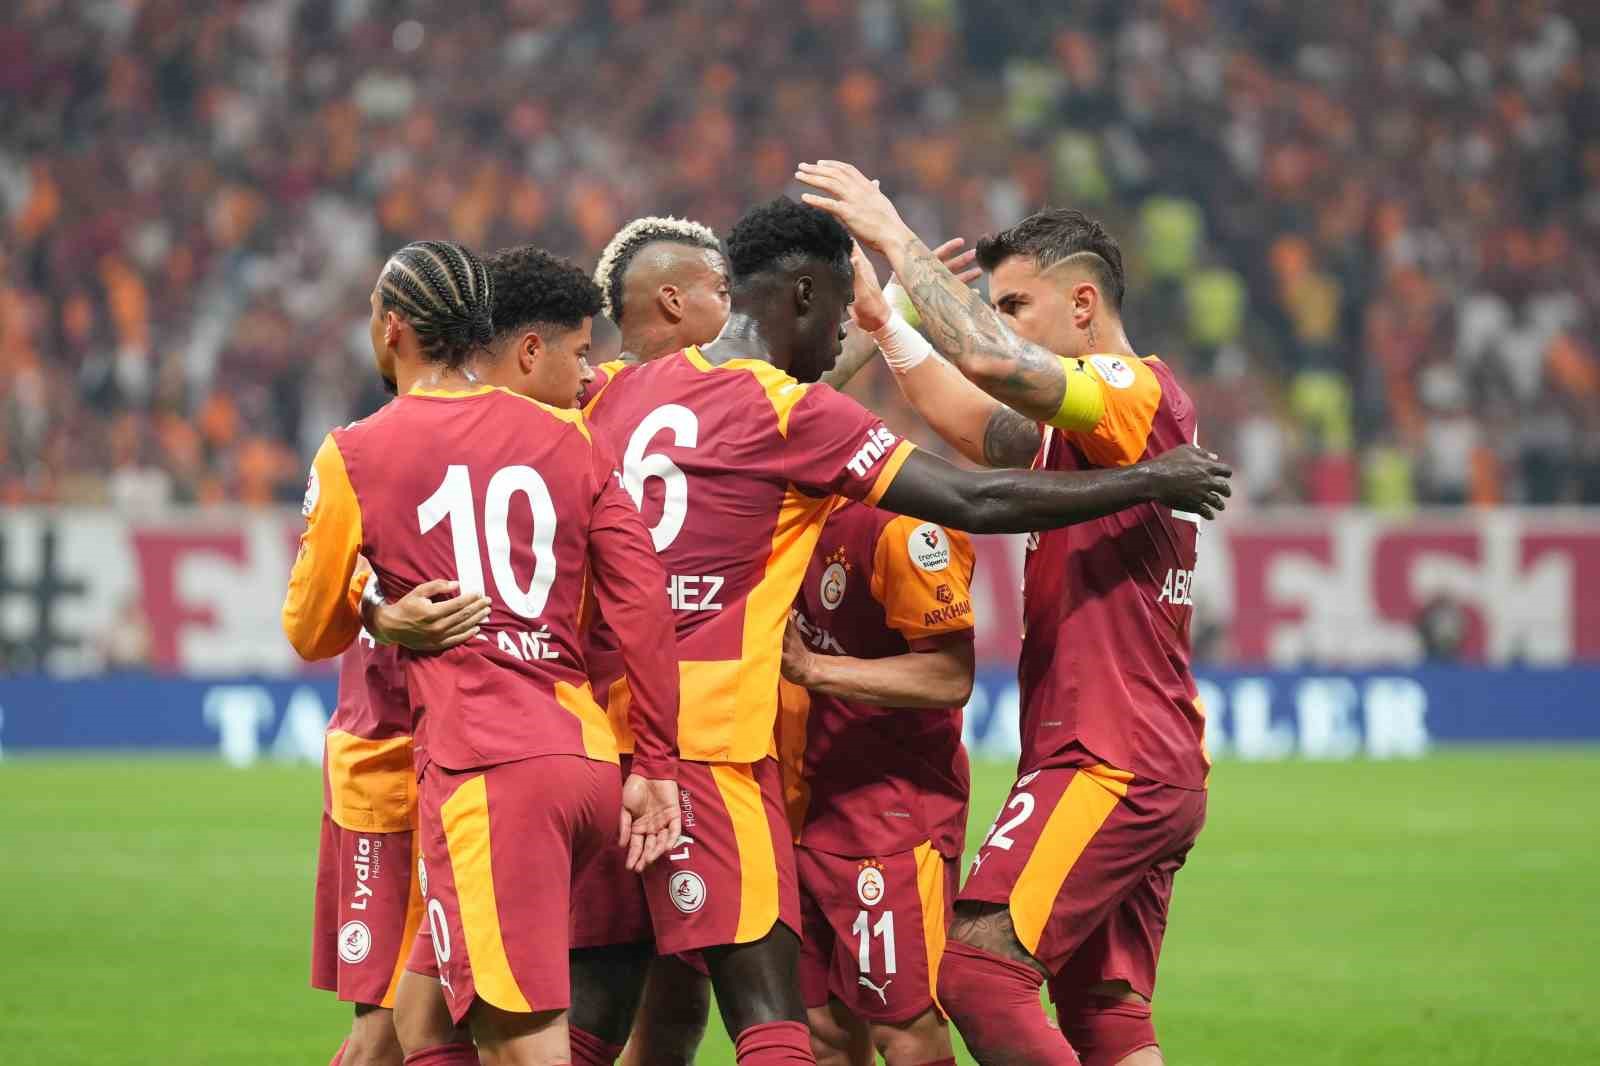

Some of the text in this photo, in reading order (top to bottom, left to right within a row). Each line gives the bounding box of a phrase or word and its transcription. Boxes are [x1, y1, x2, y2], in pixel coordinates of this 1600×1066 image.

[623, 403, 698, 553] 6
[846, 428, 896, 477] mis
[416, 464, 557, 619] 10
[667, 574, 724, 611] HEZ
[476, 624, 561, 661] ANÉ
[984, 792, 1035, 851] 2
[351, 837, 373, 910] Lydia
[371, 840, 382, 879] Holding
[427, 898, 451, 965] 0
[852, 910, 897, 974] 11
